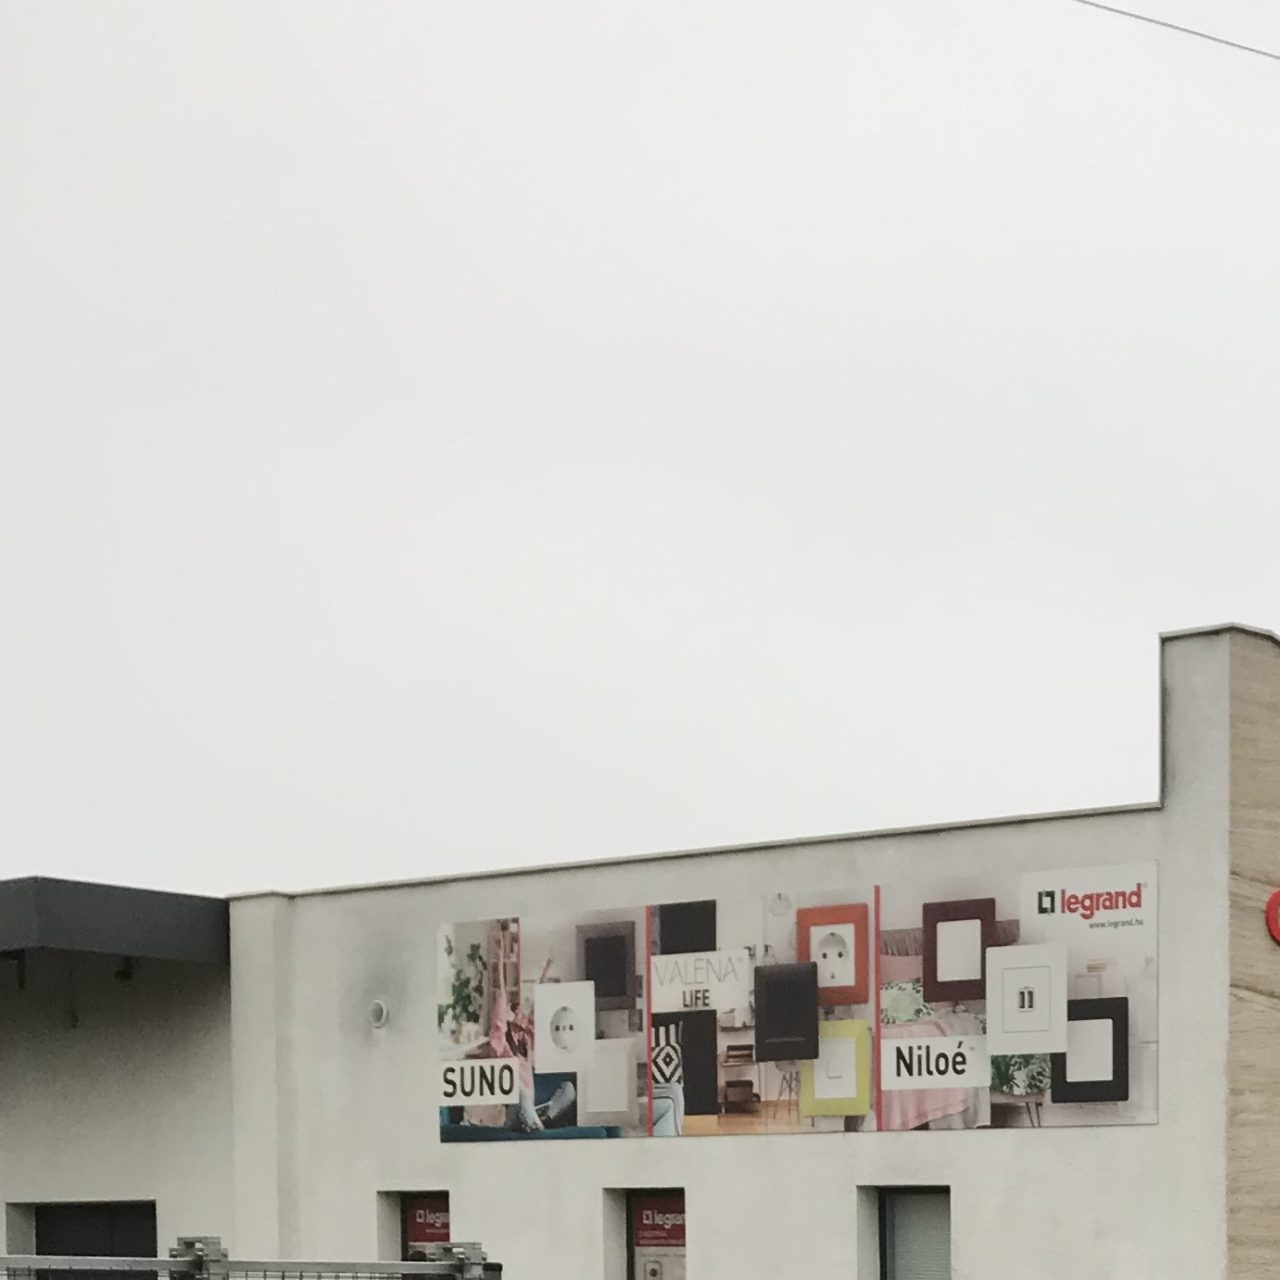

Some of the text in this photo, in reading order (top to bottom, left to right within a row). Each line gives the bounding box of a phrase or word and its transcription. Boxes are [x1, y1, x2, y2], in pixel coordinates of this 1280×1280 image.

[1060, 882, 1142, 920] legrand
[653, 957, 742, 987] VALENA
[682, 989, 710, 1008] LIFE
[896, 1041, 967, 1077] Niloé
[443, 1064, 514, 1098] SUNO
